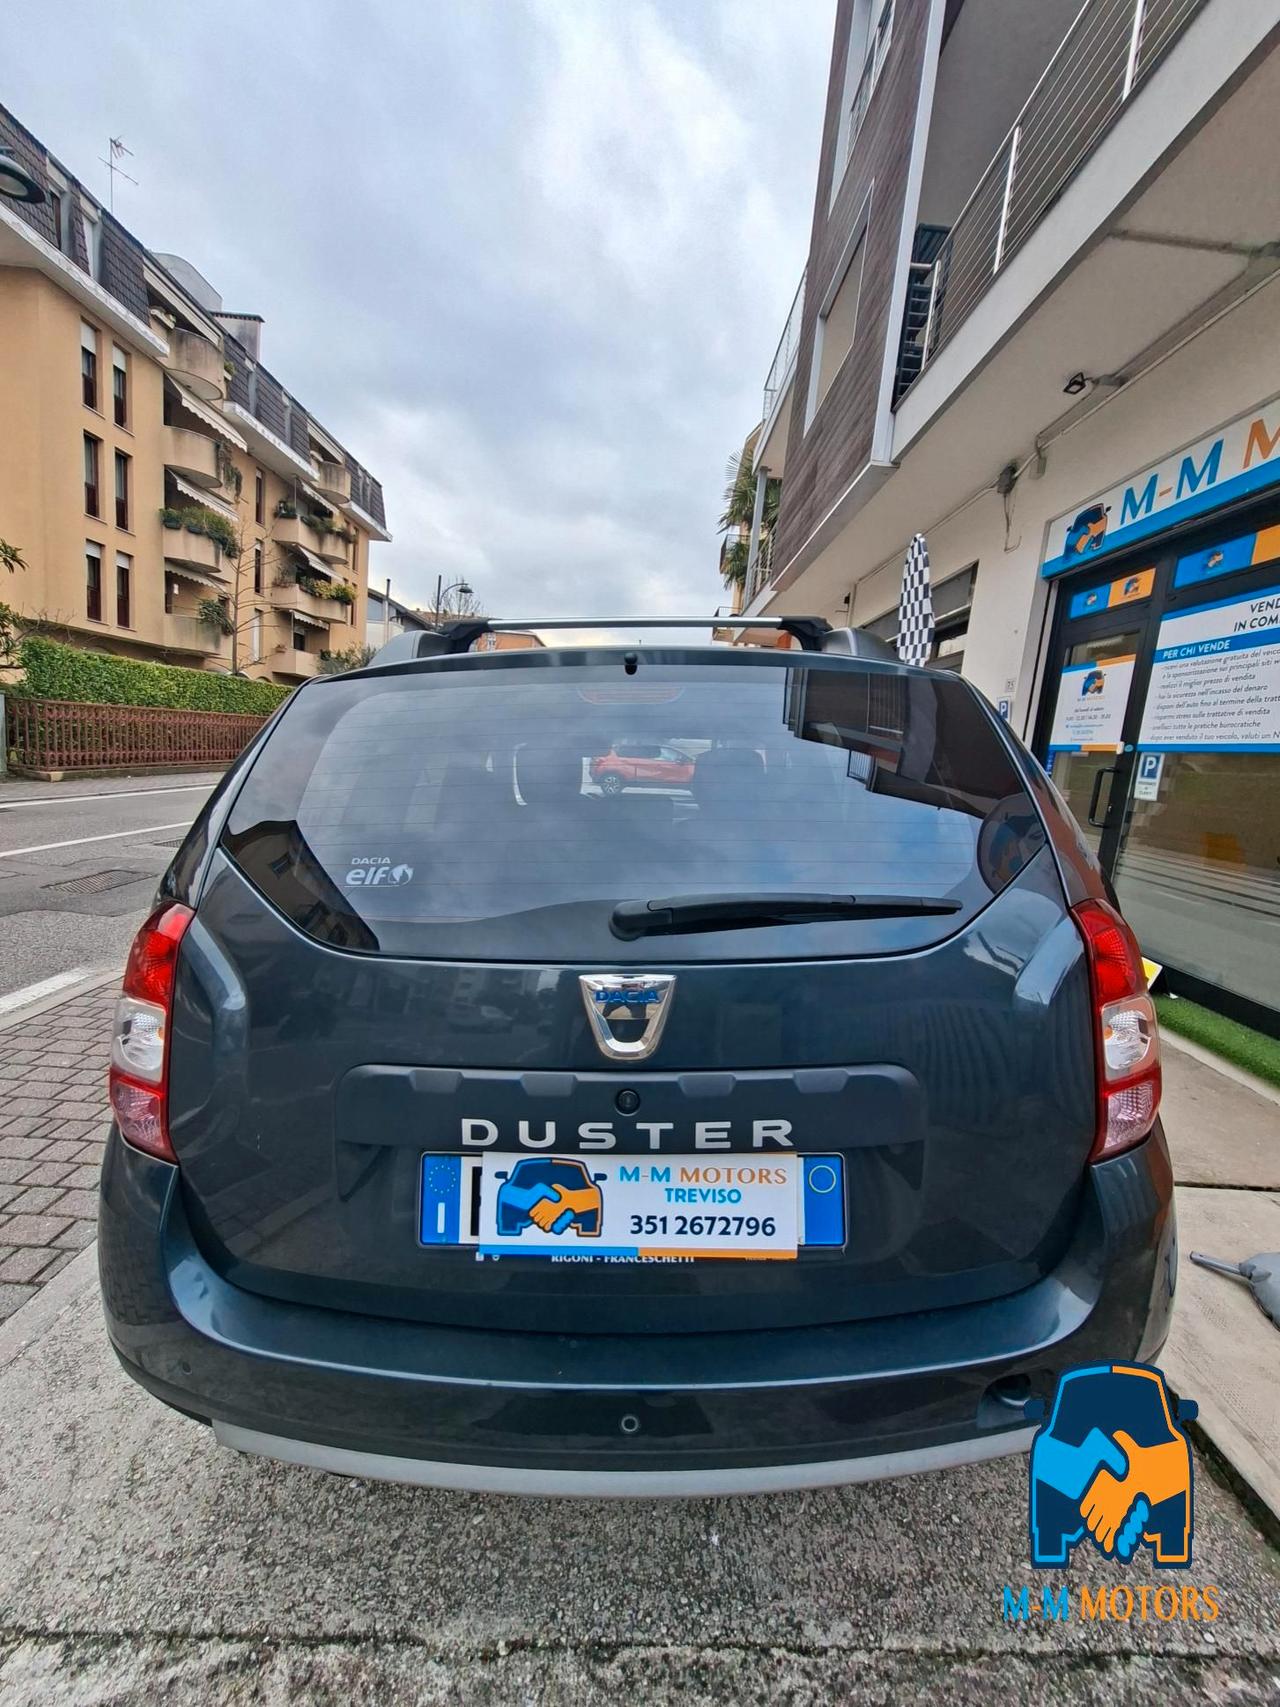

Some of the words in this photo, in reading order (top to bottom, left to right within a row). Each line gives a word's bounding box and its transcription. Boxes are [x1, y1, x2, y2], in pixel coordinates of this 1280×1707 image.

[1120, 438, 1225, 526] M-M
[1233, 620, 1248, 632] IN
[1163, 649, 1179, 660] PER
[1180, 645, 1197, 657] CHI
[1198, 639, 1231, 653] VENDE
[1250, 649, 1262, 658] del
[1231, 672, 1256, 681] vendita
[1232, 684, 1243, 693] del
[1244, 683, 1268, 692] denaro
[1219, 697, 1245, 706] termine
[1246, 694, 1262, 703] della
[1206, 708, 1236, 717] trattative
[1236, 706, 1243, 716] di
[1244, 705, 1271, 715] vendita
[1193, 720, 1219, 731] pratiche
[1219, 718, 1261, 728] burocratiche
[1143, 756, 1157, 777] P
[351, 856, 392, 865] DACIA
[345, 866, 391, 885] elf
[595, 990, 661, 1004] DACIA
[460, 1118, 794, 1151] DUSTER
[618, 1165, 671, 1184] M-M
[679, 1166, 787, 1185] MOTORS
[664, 1187, 742, 1205] TREVISO
[629, 1214, 668, 1236] 351
[674, 1215, 776, 1237] 2672796
